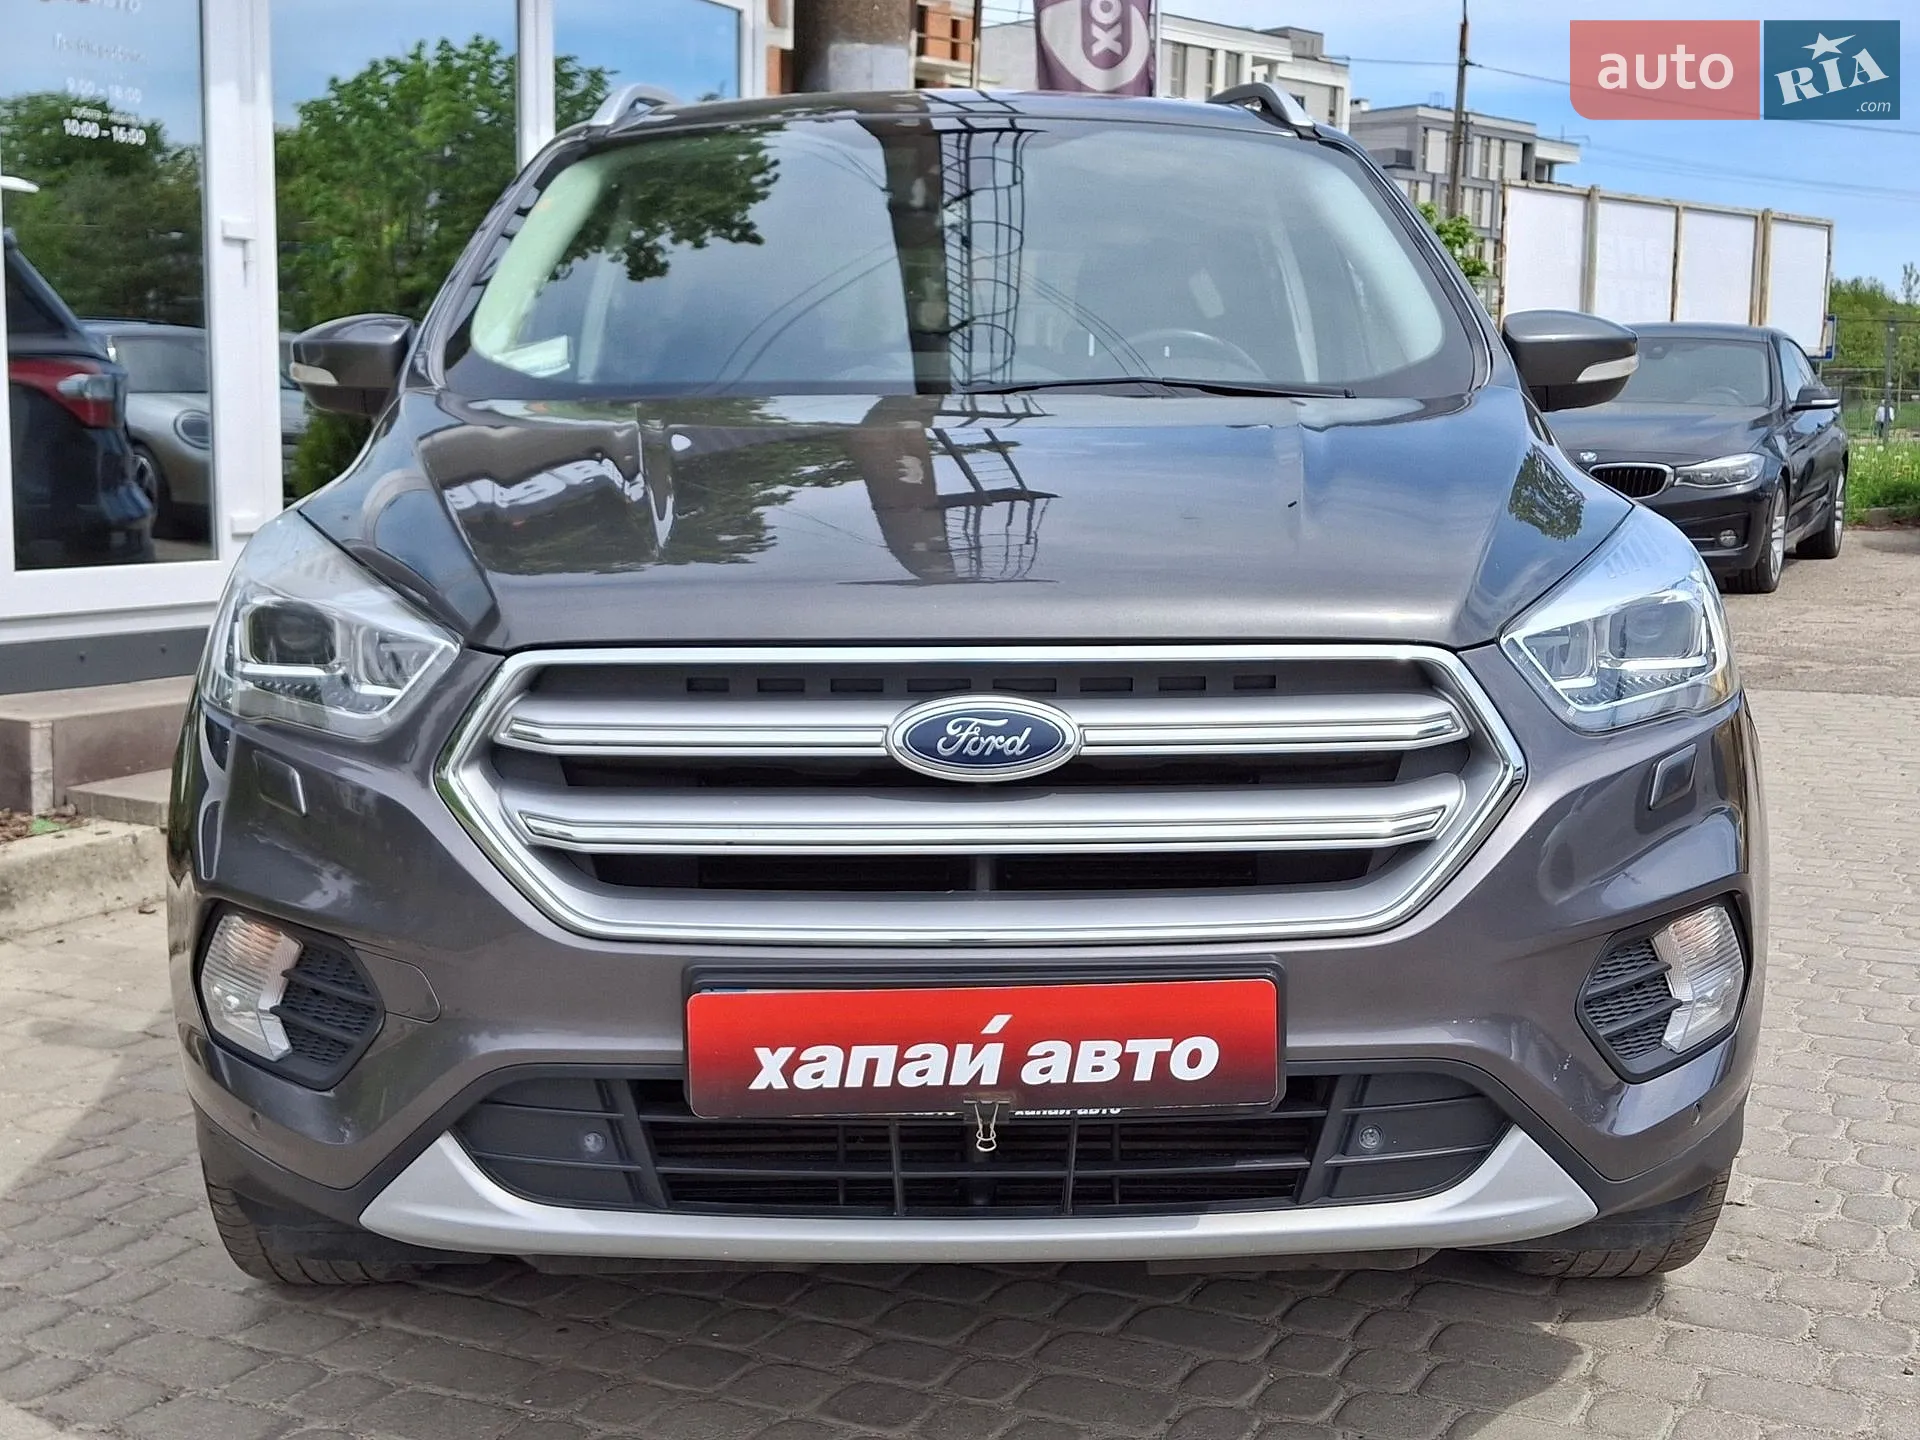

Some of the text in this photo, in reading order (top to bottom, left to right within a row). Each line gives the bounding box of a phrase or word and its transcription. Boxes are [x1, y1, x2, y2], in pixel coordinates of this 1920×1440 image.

[63, 118, 100, 140] 10:00
[936, 717, 1032, 756] Ford
[1020, 1036, 1219, 1086] авто
